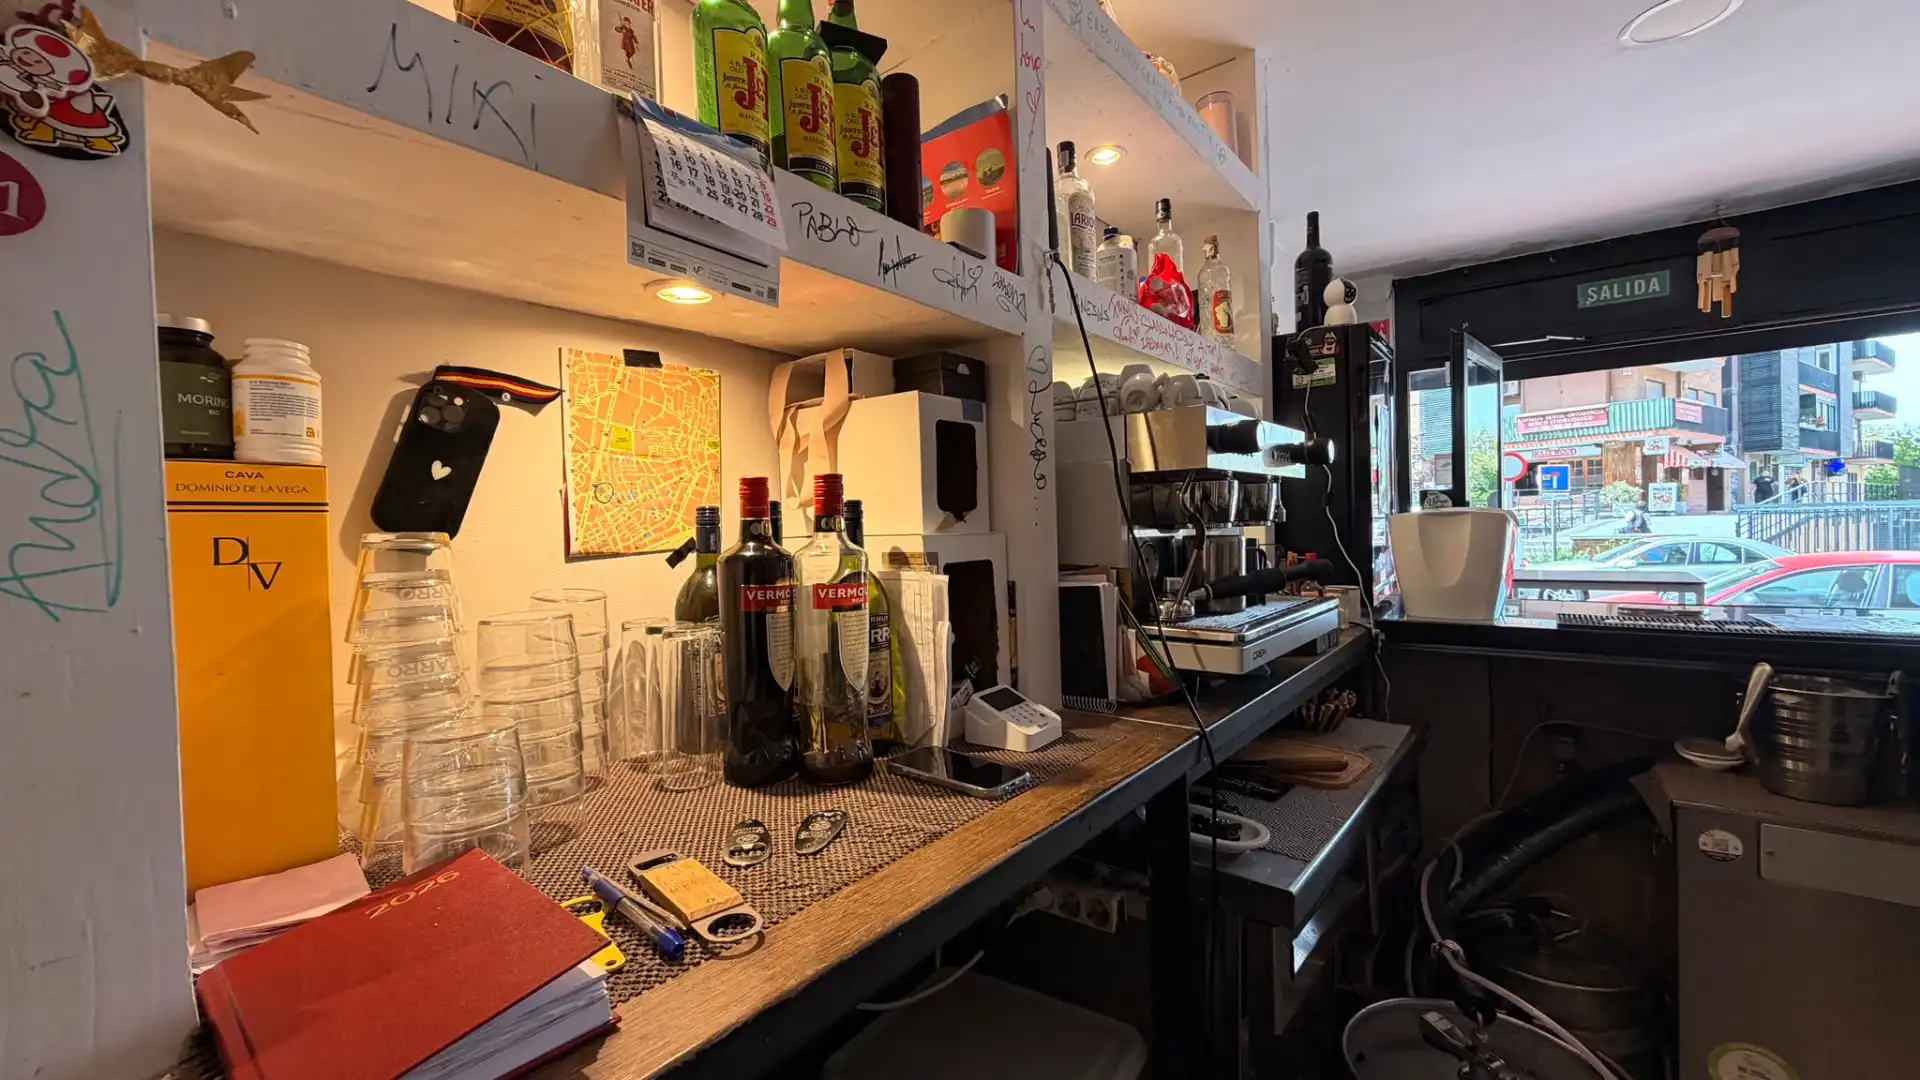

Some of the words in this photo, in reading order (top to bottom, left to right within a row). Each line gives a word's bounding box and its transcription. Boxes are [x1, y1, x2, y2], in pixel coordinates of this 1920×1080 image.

[670, 157, 682, 170] 16
[688, 165, 699, 177] 17
[704, 173, 715, 186] 18
[706, 187, 719, 200] 25
[1587, 277, 1660, 302] SALIDA
[225, 470, 265, 479] CAVA
[176, 483, 239, 492] DOMINIO
[275, 486, 309, 494] VEGA
[365, 870, 459, 919] 2026
